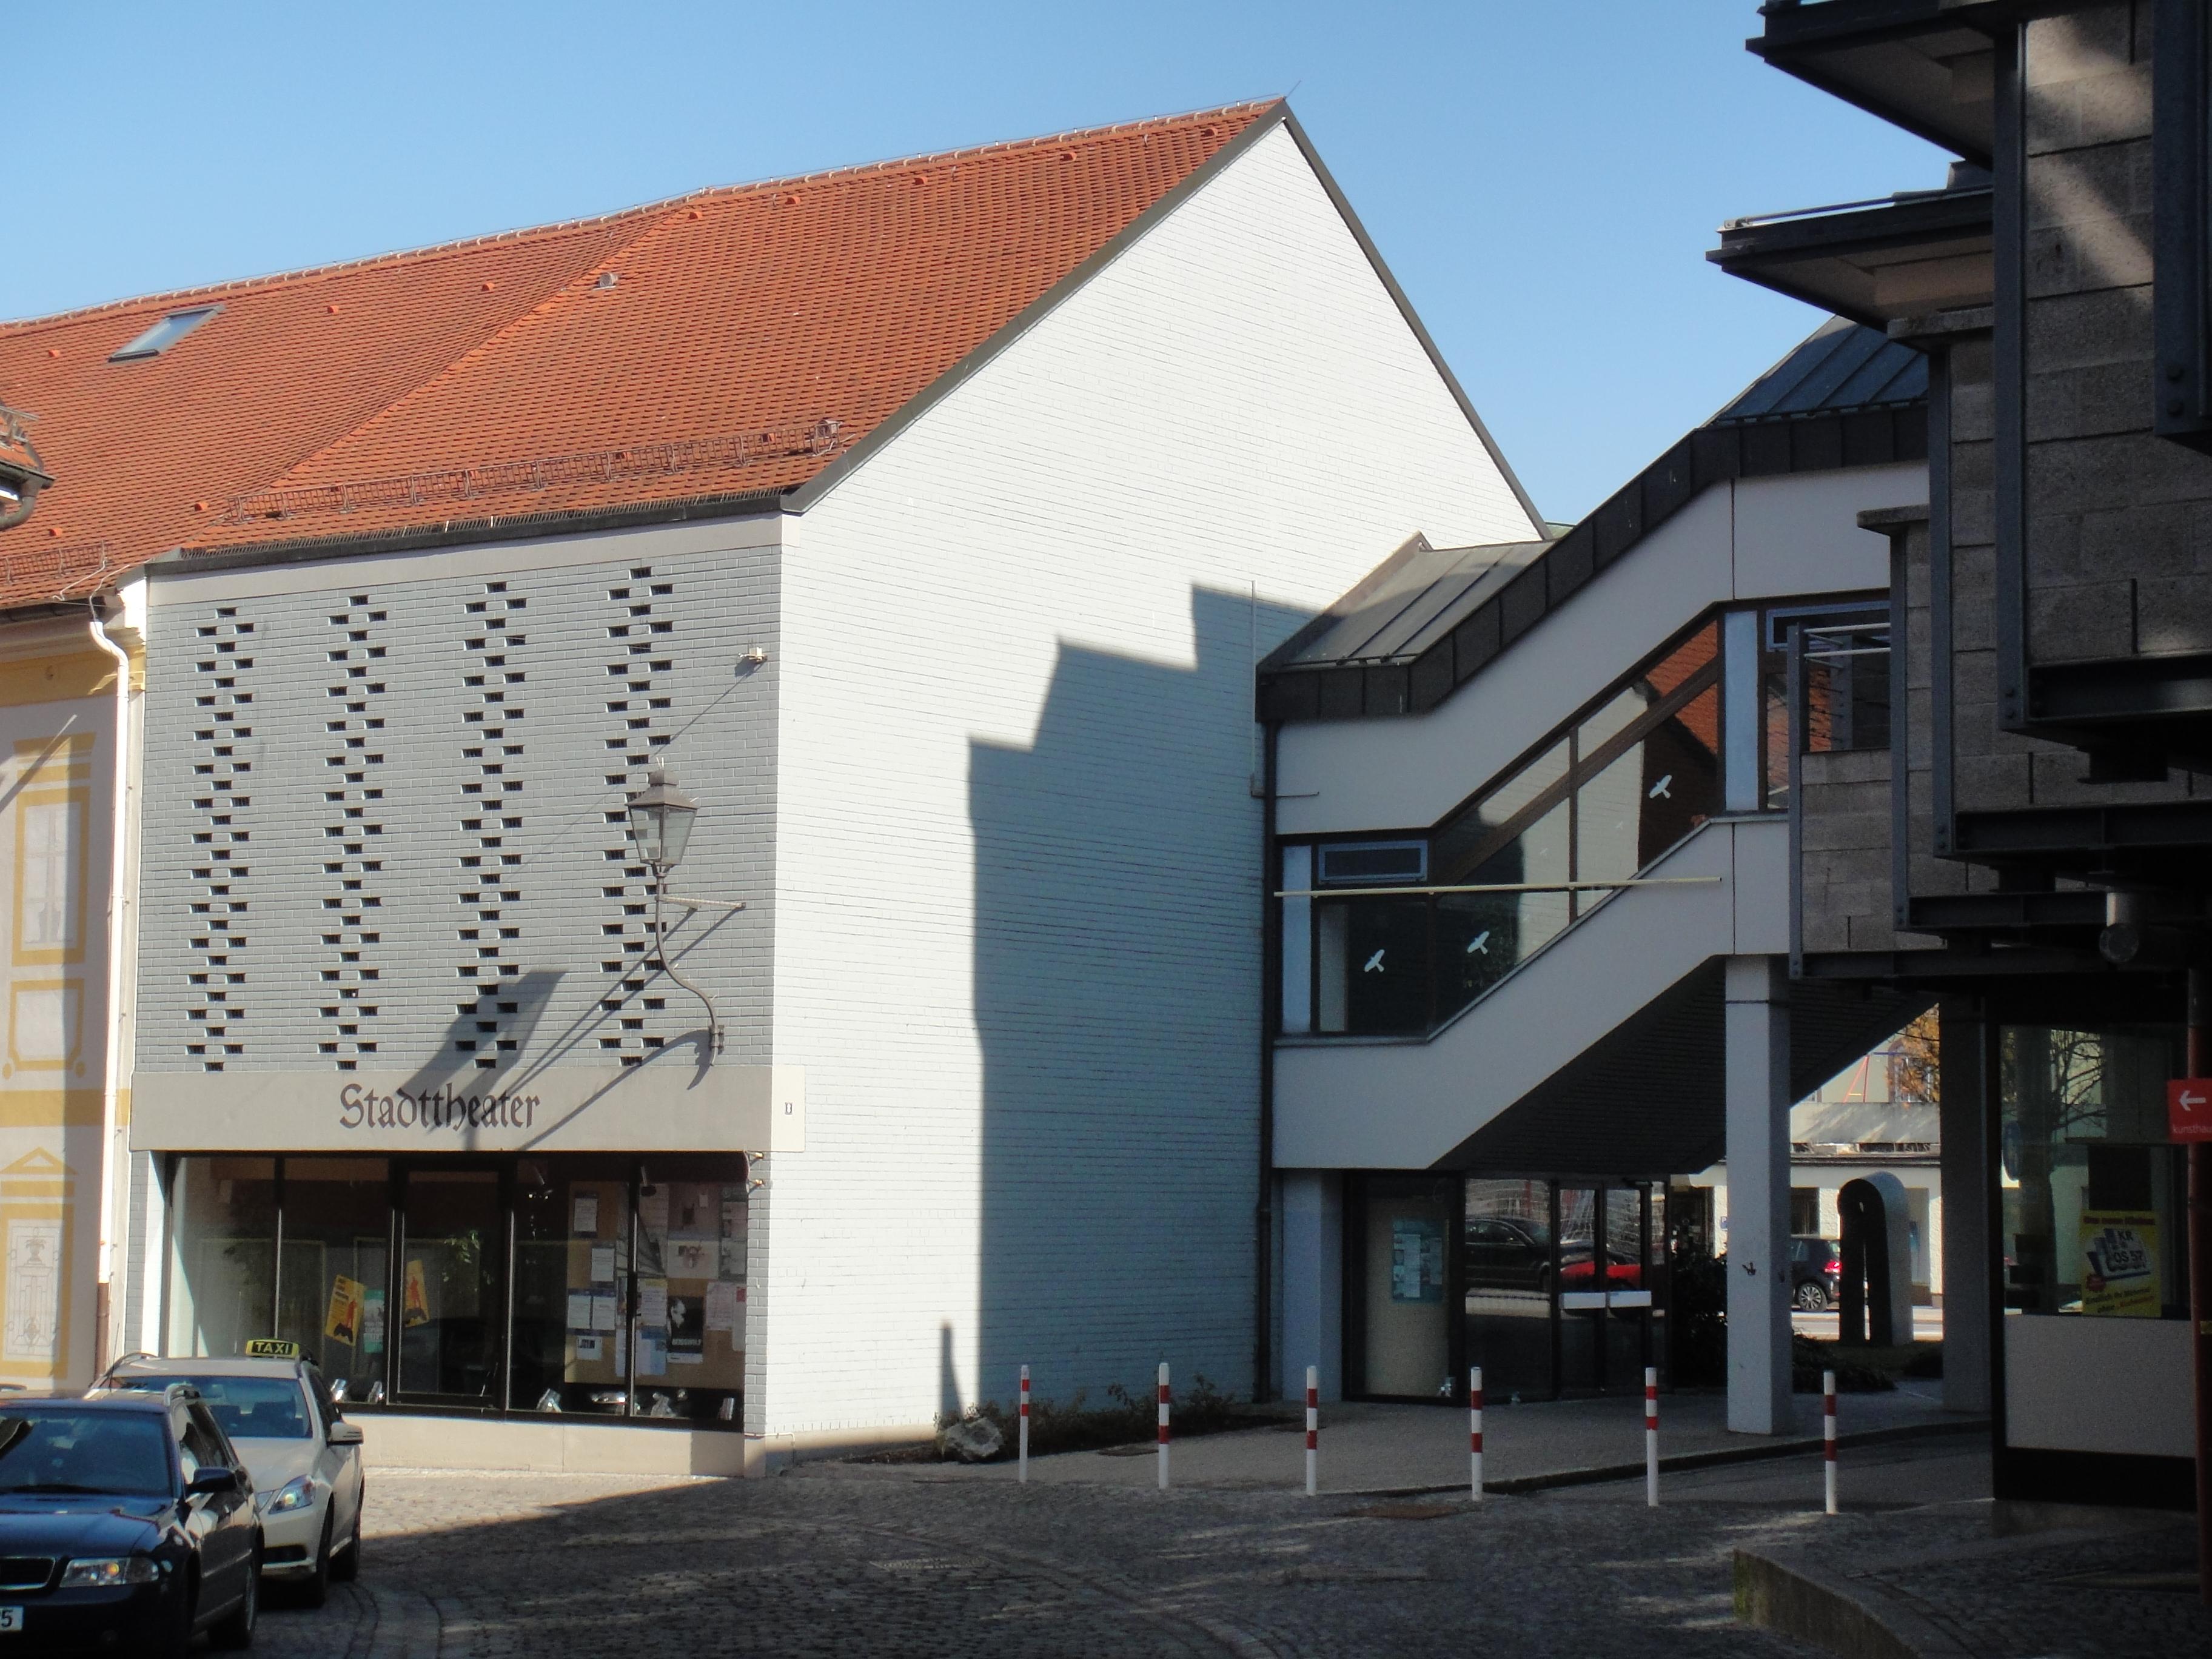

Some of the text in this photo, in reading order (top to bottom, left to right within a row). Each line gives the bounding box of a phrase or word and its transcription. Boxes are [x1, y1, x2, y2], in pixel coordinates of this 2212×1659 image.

[339, 1082, 540, 1131] Stadttheater
[255, 1342, 289, 1354] TAXI
[0, 1609, 13, 1627] 5
